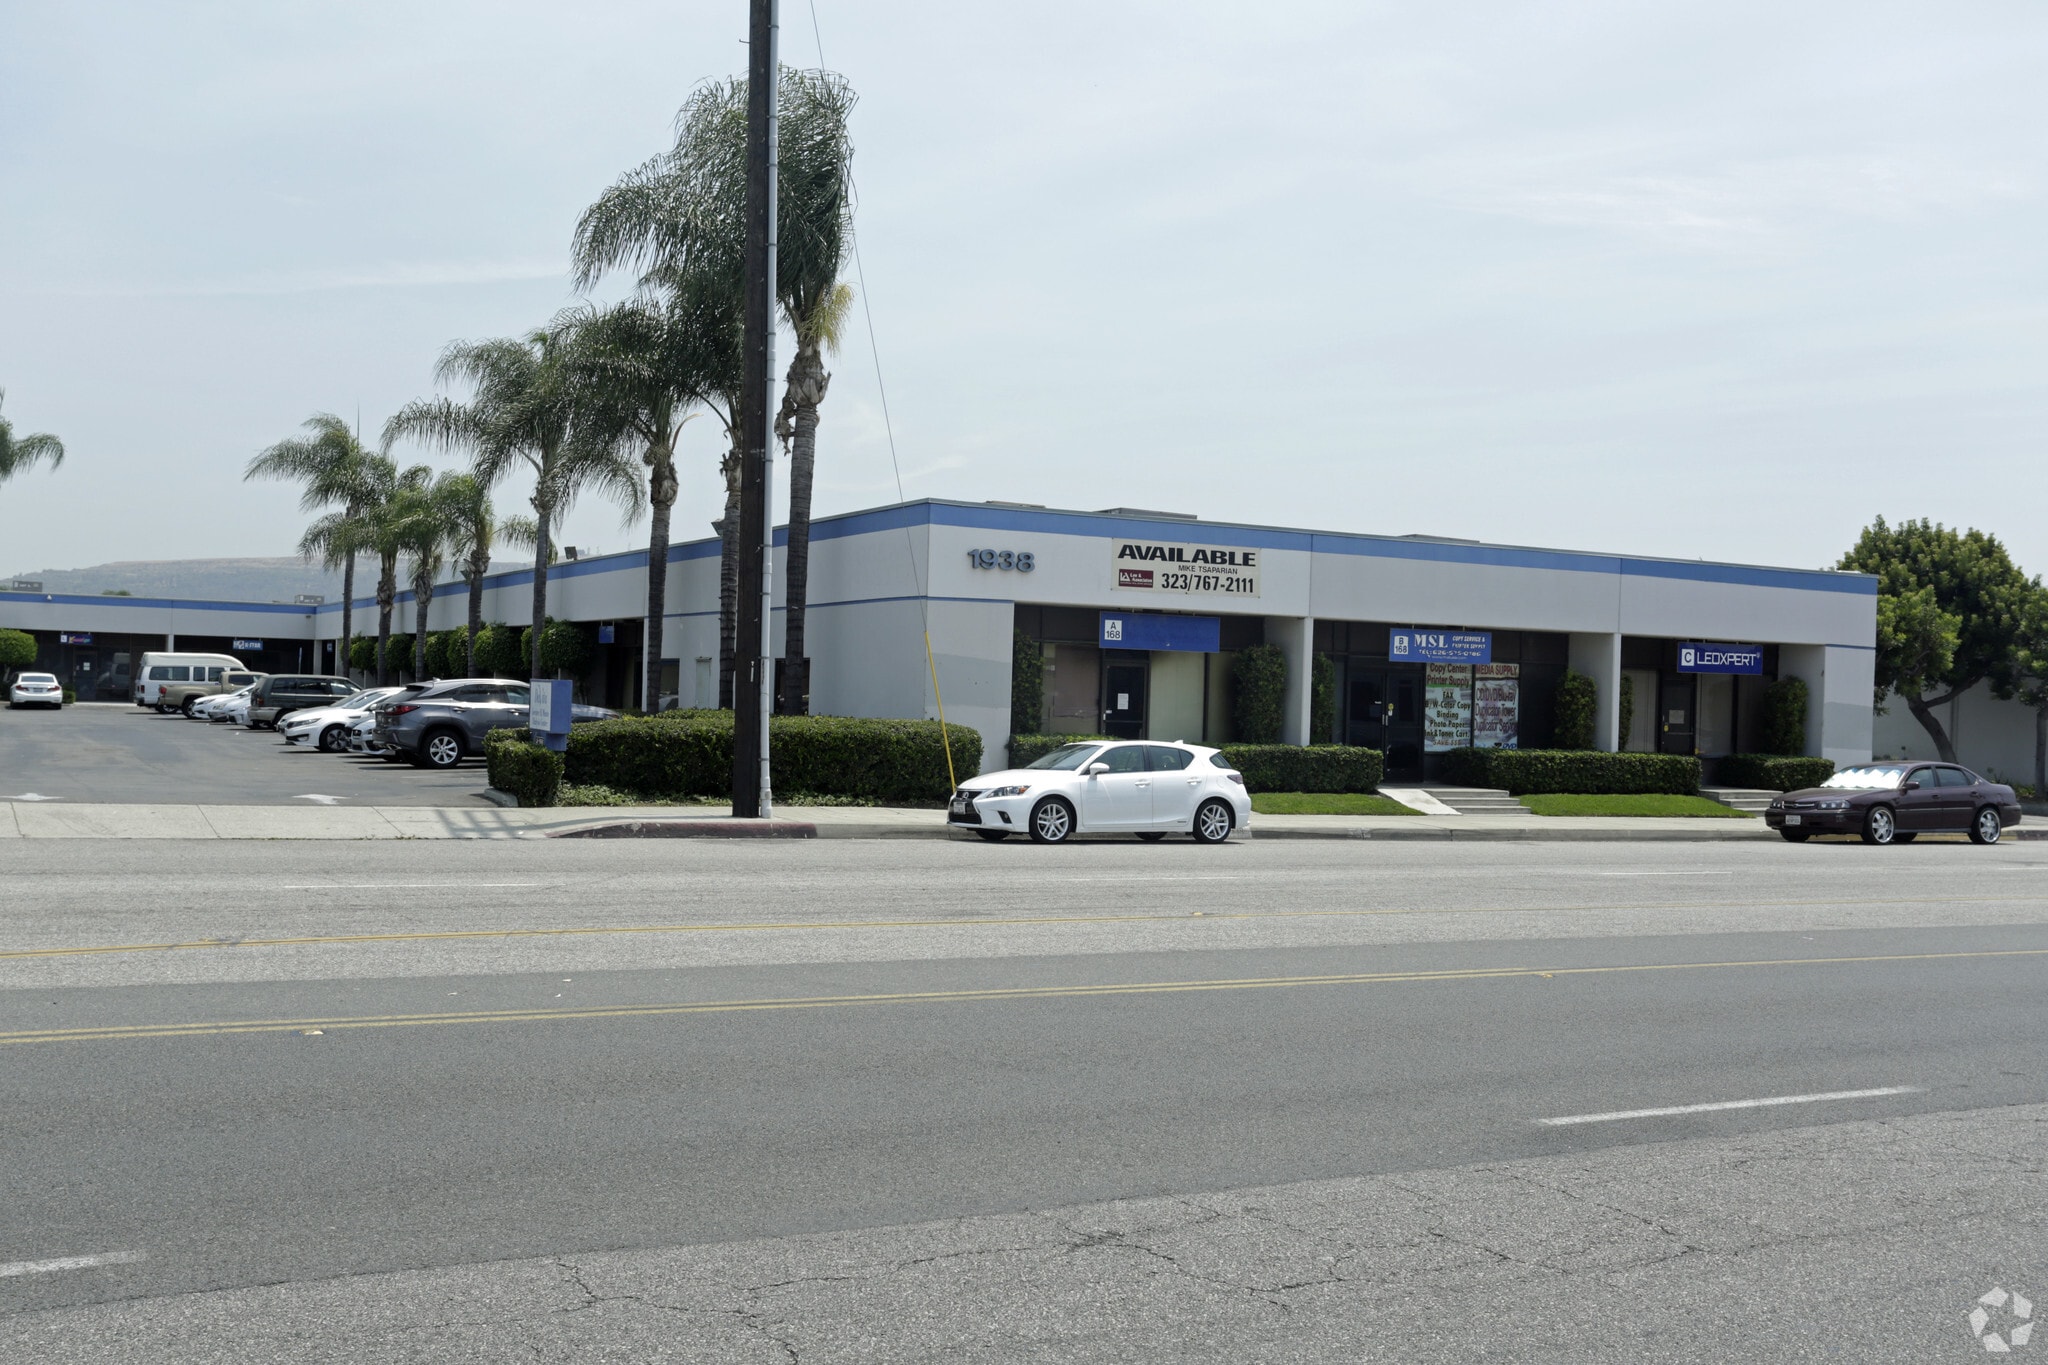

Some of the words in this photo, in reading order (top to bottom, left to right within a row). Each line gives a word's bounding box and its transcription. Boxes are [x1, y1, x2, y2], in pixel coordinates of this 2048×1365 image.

[967, 549, 1035, 572] 1938
[1118, 544, 1256, 567] AVAILABLE
[1198, 566, 1238, 575] TSAPARIAN
[1161, 573, 1253, 593] 323/767-2111
[1111, 622, 1116, 630] A
[1106, 630, 1121, 639] 168
[1399, 637, 1404, 645] B
[1414, 634, 1448, 648] MSL
[1684, 652, 1692, 663] C
[1430, 663, 1446, 674] Copy
[1447, 664, 1468, 674] Center
[1476, 664, 1494, 674] MEDIA
[1496, 665, 1518, 675] SUPPLY
[1427, 675, 1448, 685] Printer
[1449, 676, 1470, 688] Supply
[1457, 702, 1471, 711] Copy
[1437, 711, 1459, 720] Binding
[1430, 720, 1447, 728] Photo
[1449, 721, 1465, 729] Paper
